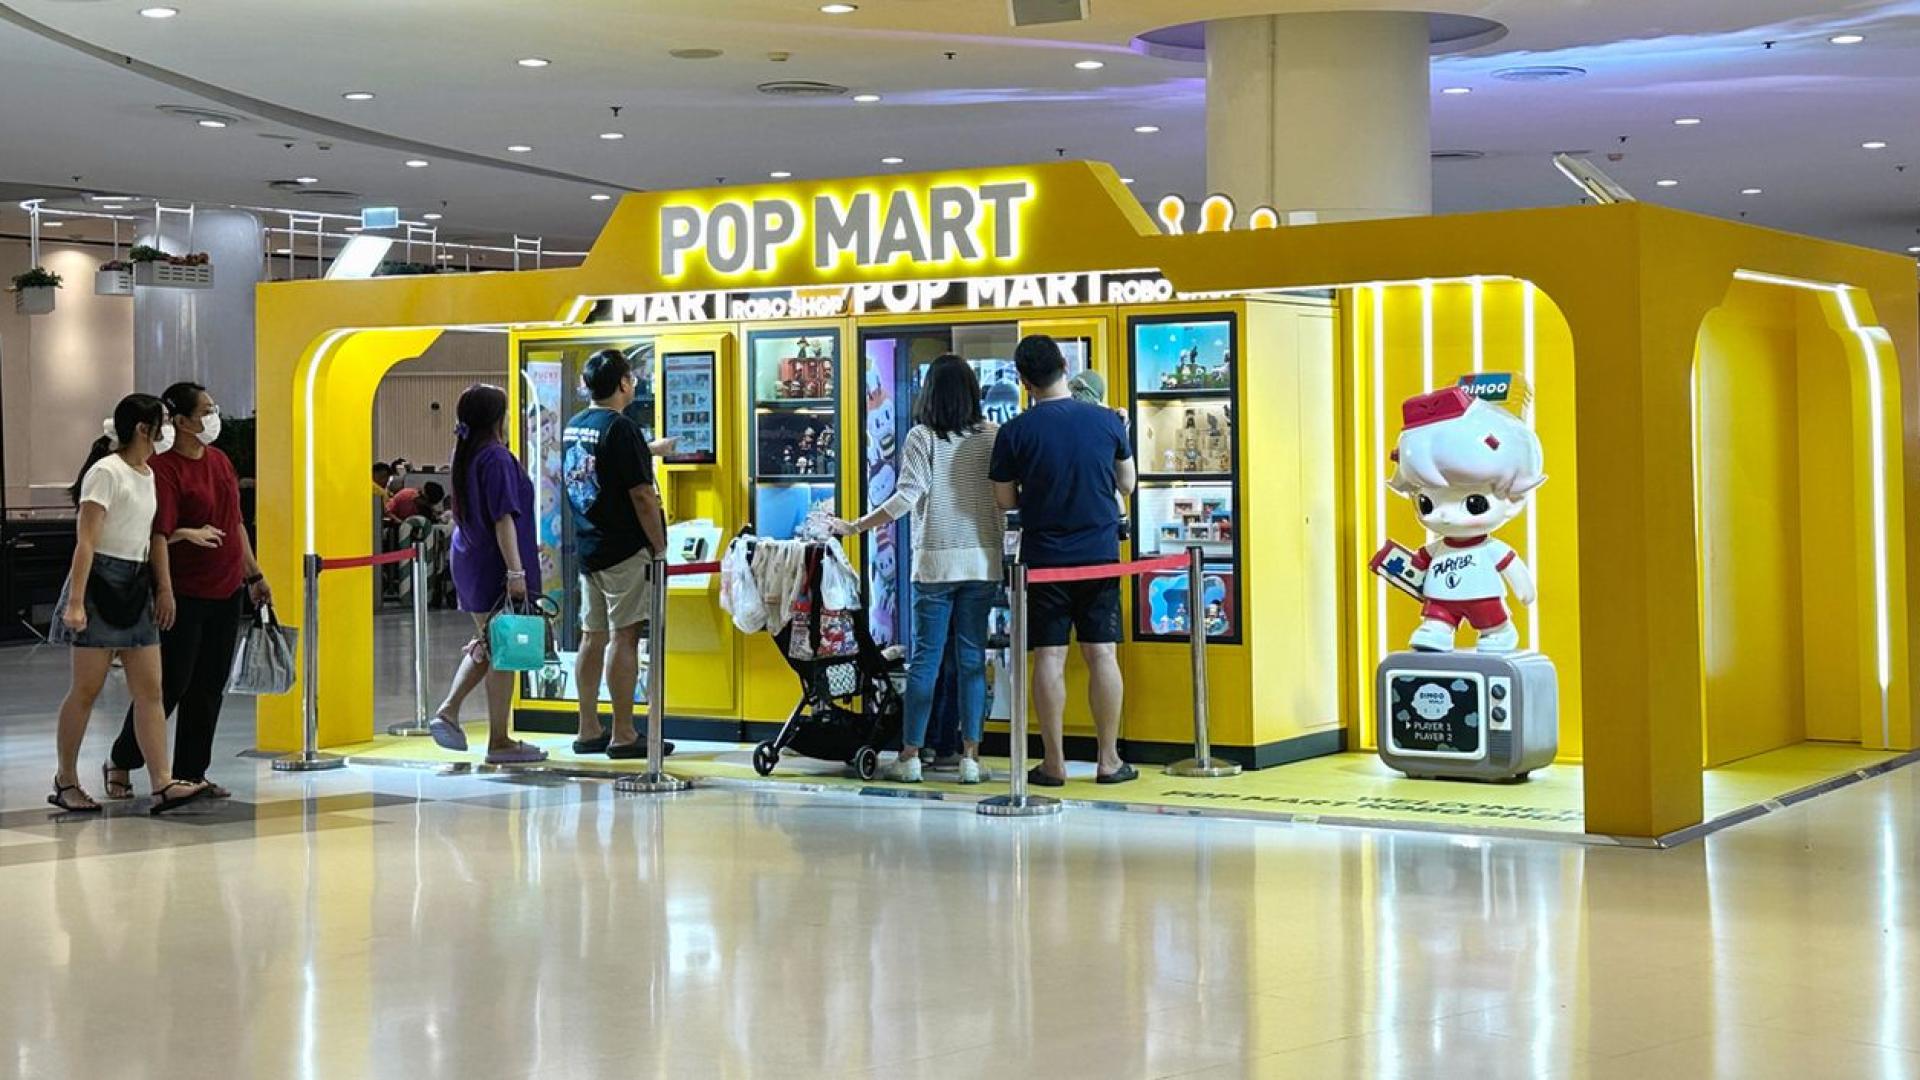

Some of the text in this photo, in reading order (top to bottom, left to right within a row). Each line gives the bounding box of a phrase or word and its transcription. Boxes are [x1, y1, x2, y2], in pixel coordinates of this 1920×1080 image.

[660, 182, 1029, 276] POP MART
[731, 299, 787, 319] ROBO
[789, 295, 844, 317] SHOP
[854, 281, 950, 315] POP
[1108, 278, 1172, 304] ROBO
[1432, 554, 1476, 578] PLAYER
[1413, 721, 1452, 732] PLAYER 1
[1414, 732, 1453, 742] PLAYER 2
[1161, 789, 1240, 799] POP
[1241, 796, 1357, 807] MART
